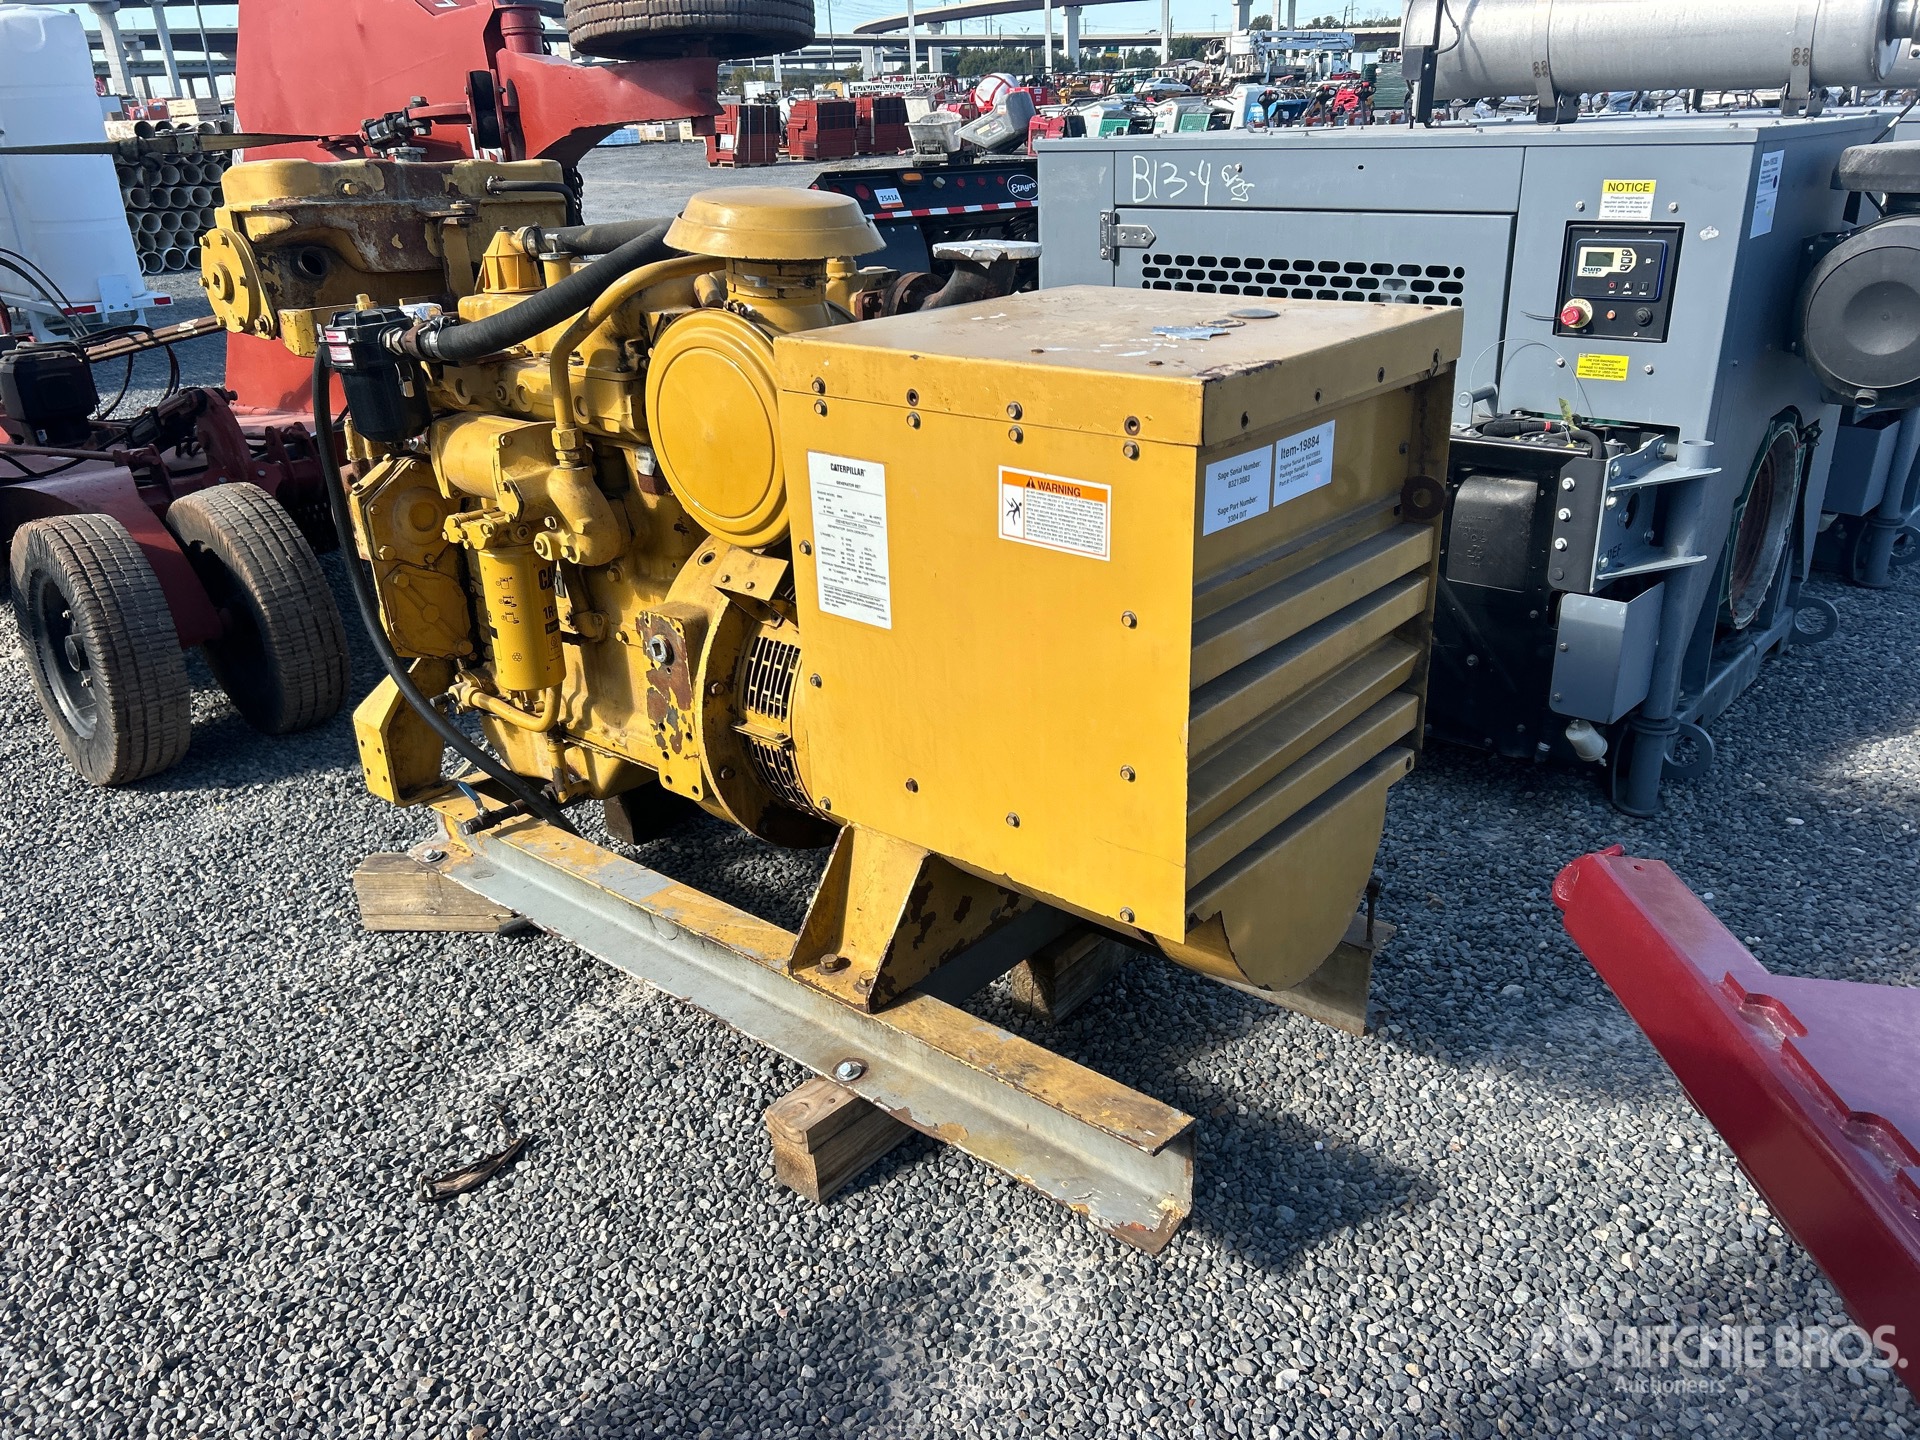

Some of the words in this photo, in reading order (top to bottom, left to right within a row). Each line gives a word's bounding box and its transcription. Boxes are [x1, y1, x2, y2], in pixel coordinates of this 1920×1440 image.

[1011, 182, 1036, 194] Etnyre
[1608, 182, 1650, 192] NOTICE
[1281, 435, 1319, 460] Item-19884
[830, 463, 865, 477] CATERPILLAR
[1218, 470, 1229, 480] Sage
[1230, 465, 1242, 476] Serial
[1243, 461, 1262, 472] Number:
[1038, 480, 1080, 497] WARNING
[1217, 506, 1229, 516] Sage
[1229, 502, 1238, 511] Part
[1239, 496, 1258, 507] Number:
[1227, 513, 1238, 523] 3304
[538, 566, 556, 590] CA
